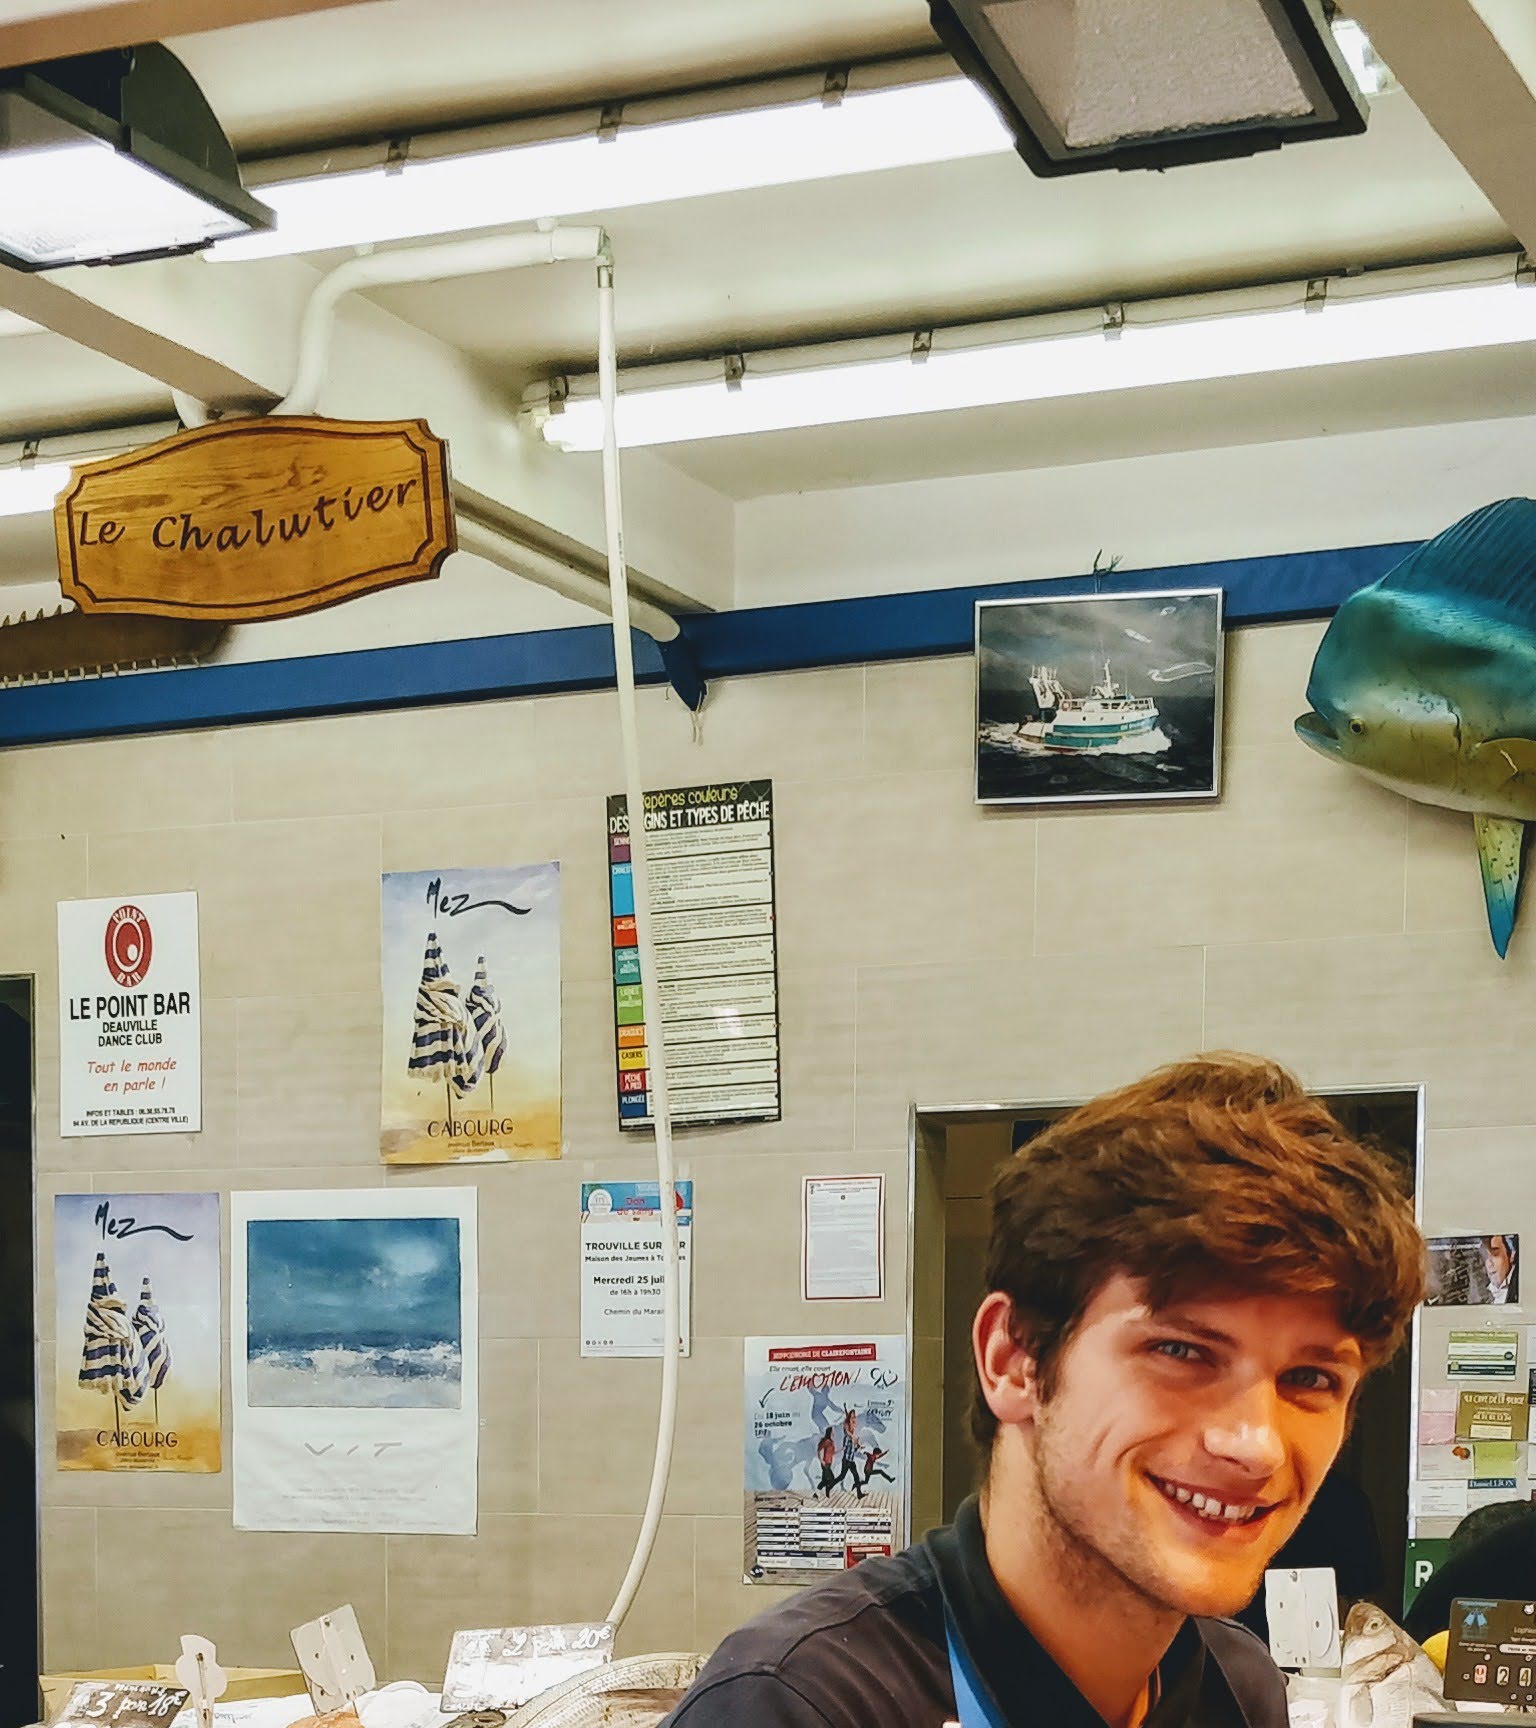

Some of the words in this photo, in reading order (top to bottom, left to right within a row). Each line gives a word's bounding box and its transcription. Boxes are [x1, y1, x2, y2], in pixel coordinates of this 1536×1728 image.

[80, 510, 126, 547] Le
[152, 477, 419, 552] Chalutier
[688, 786, 738, 803] couleurs
[610, 816, 629, 833] DES
[670, 809, 685, 827] ET
[686, 806, 718, 825] TYPES
[721, 805, 734, 822] DE
[737, 800, 770, 820] PÊCHE
[70, 998, 91, 1020] LE
[96, 994, 148, 1019] POINT
[153, 992, 190, 1015] BAR
[102, 1019, 157, 1033] DEAUVILLE
[98, 1034, 133, 1047] DANCE
[135, 1033, 162, 1045] CLUB
[87, 1061, 116, 1074] Tout
[120, 1059, 131, 1072] le
[137, 1057, 176, 1072] monde
[104, 1081, 118, 1092] en
[123, 1077, 155, 1094] parle
[427, 1119, 514, 1137] CABOURG
[585, 1242, 640, 1251] TROUVILLE
[593, 1276, 634, 1284] Mercredi
[96, 1431, 178, 1447] CABOURG
[1414, 1560, 1433, 1588] R
[85, 1691, 115, 1718] 3
